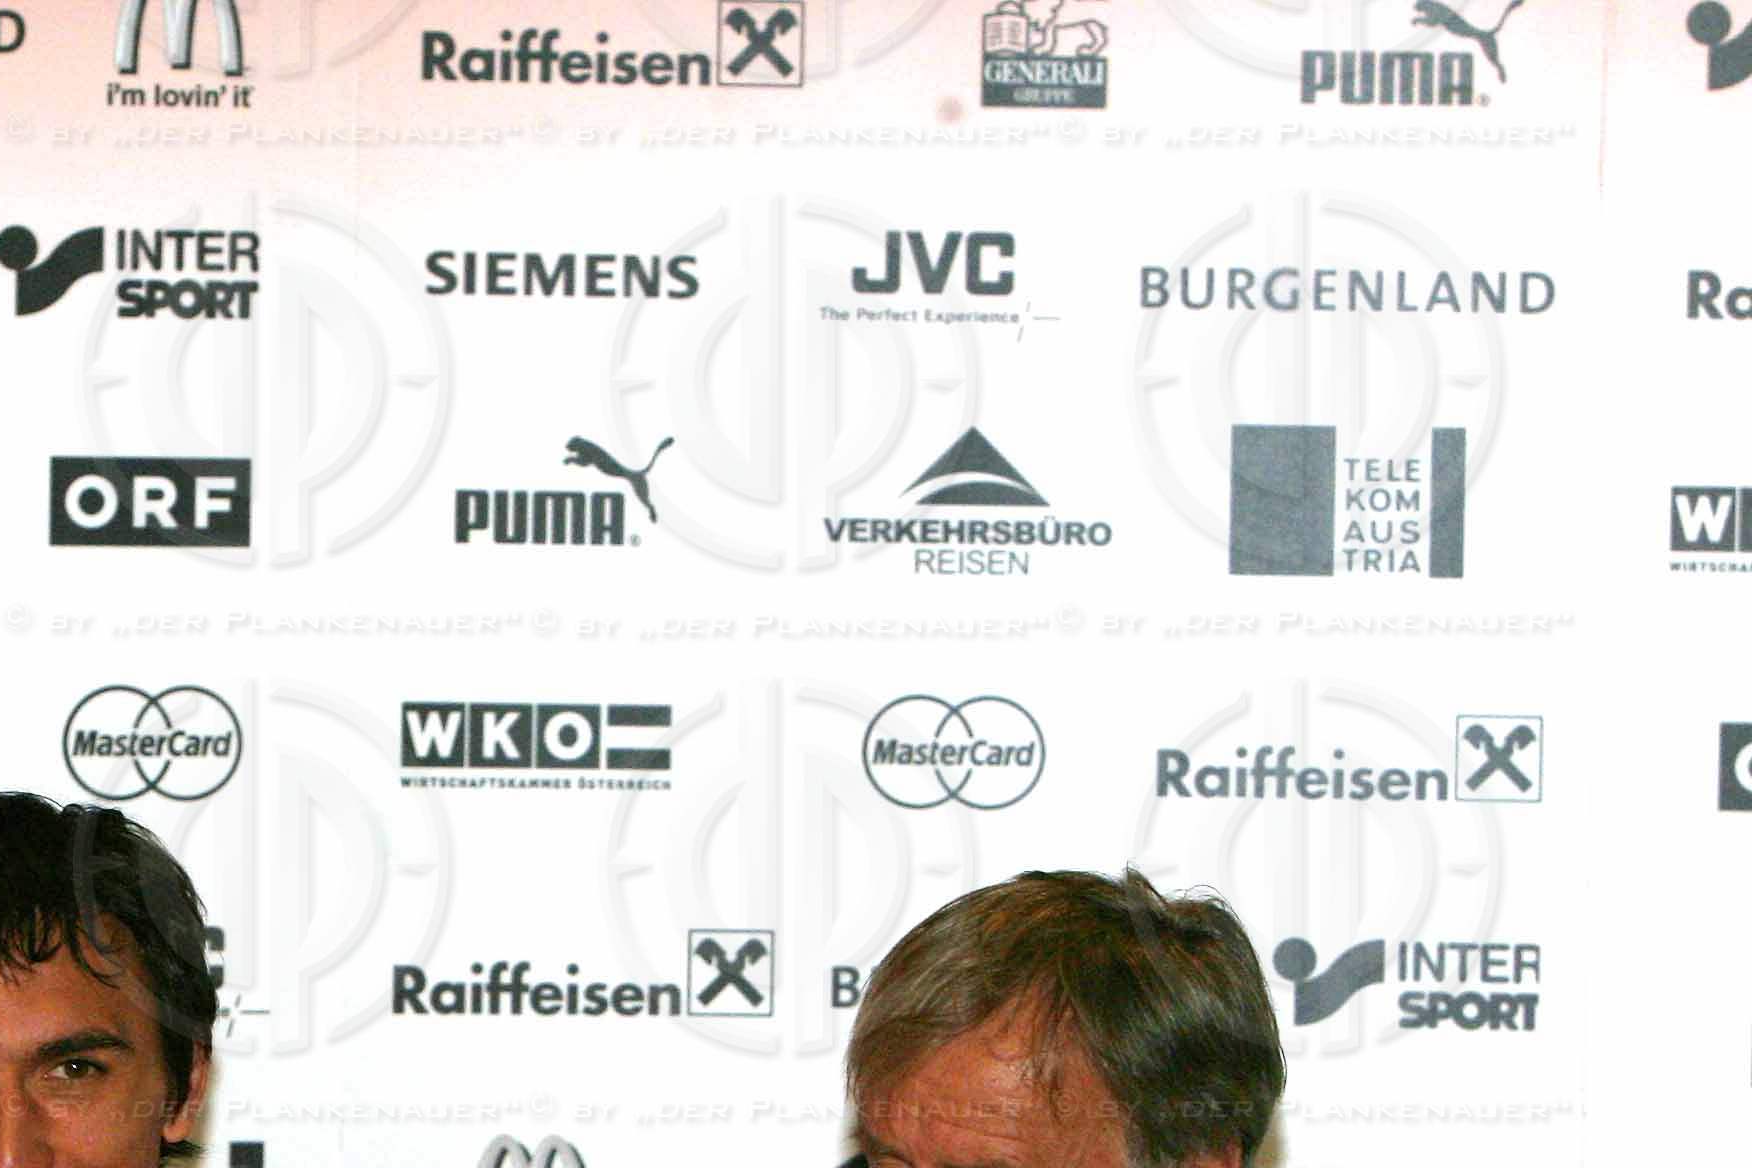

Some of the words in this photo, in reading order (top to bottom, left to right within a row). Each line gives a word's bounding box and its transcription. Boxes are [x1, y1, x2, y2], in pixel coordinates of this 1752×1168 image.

[421, 28, 711, 86] Raiffeisen
[983, 60, 1106, 85] GENERALI
[1300, 50, 1474, 106] PUMA
[106, 83, 146, 106] i'm
[154, 84, 227, 107] lovin'
[117, 229, 260, 273] INTER
[851, 231, 1015, 296] JVC
[425, 250, 699, 300] SIEMENS
[1140, 266, 1555, 315] BURGENLAND
[116, 279, 259, 320] SPORT
[1344, 458, 1420, 483] TELE
[63, 475, 238, 530] ORF
[454, 489, 625, 546] PUMA
[1346, 488, 1420, 513] KOM
[824, 518, 1112, 546] VERKEHRSBÜRO
[1343, 520, 1421, 545] AUS
[914, 549, 1029, 575] REISEN
[1342, 548, 1421, 573] TRIA
[72, 727, 233, 760] MasterCard
[405, 710, 594, 761] WKO
[871, 737, 1036, 769] MasterCard
[1156, 746, 1448, 801] Raiffeisen
[1398, 941, 1540, 985] INTER
[392, 961, 681, 1016] Raiffeisen
[1398, 991, 1539, 1031] SPORT
